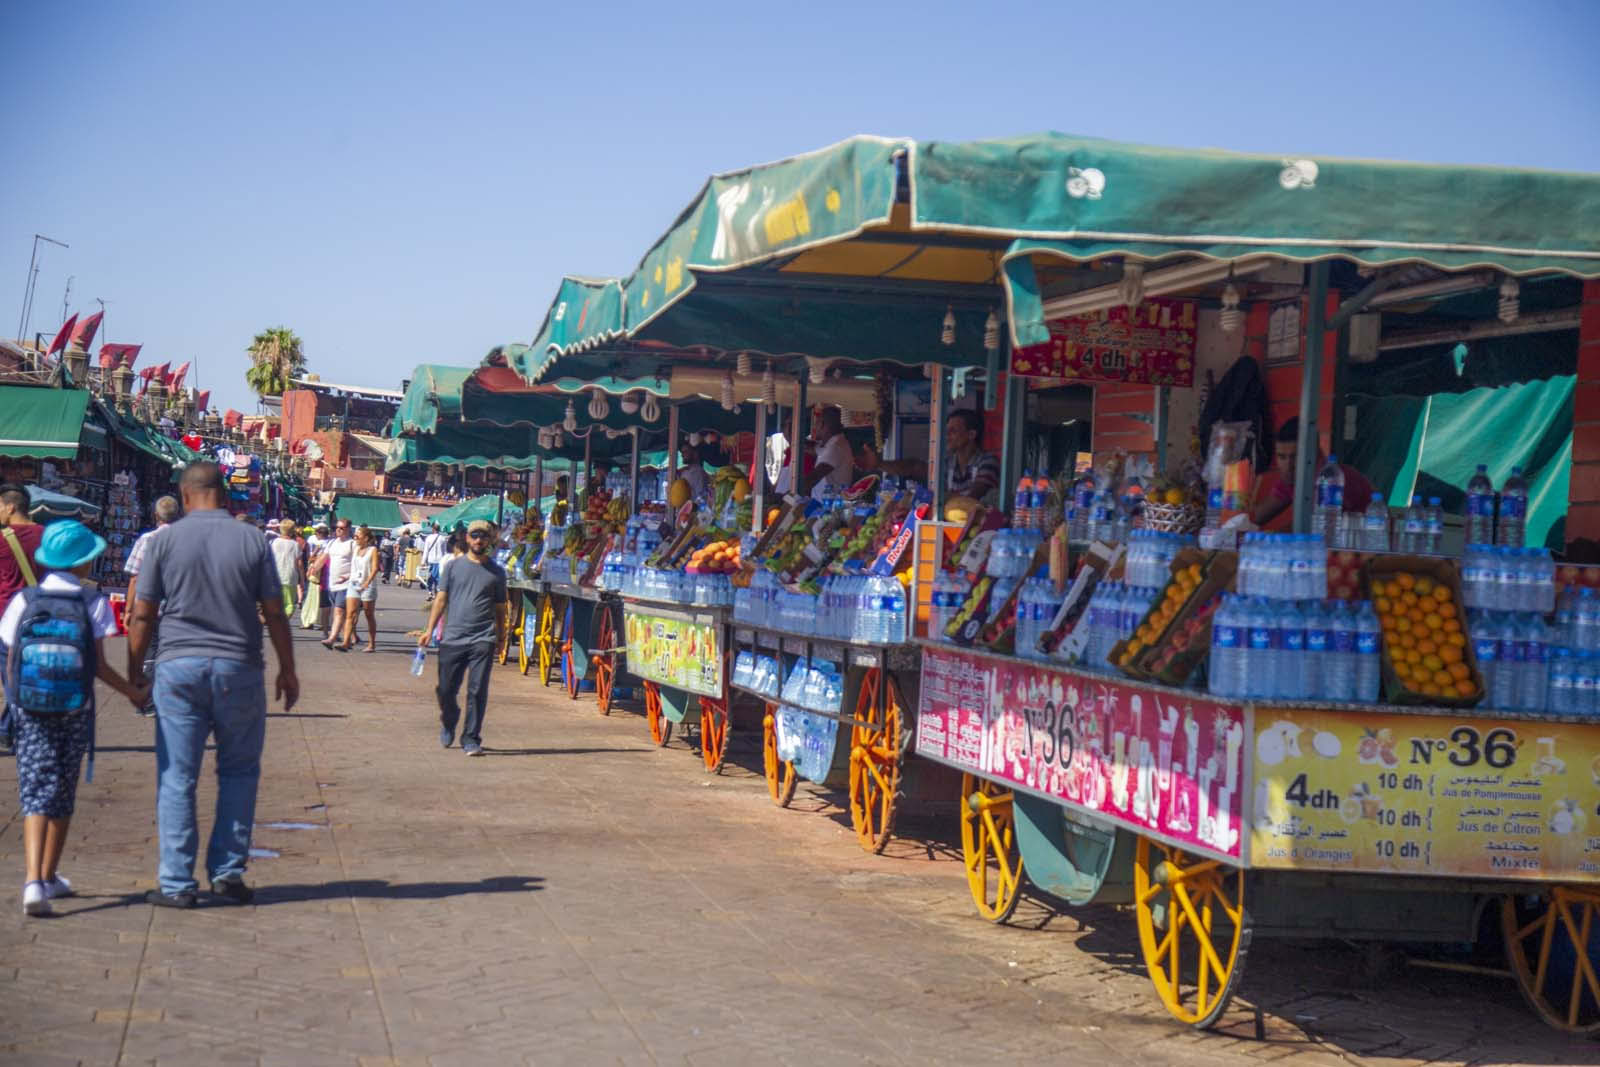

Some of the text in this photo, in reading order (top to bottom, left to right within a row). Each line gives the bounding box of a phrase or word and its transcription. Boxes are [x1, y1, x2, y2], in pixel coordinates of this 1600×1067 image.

[1082, 348, 1126, 368] 4 dh
[1379, 772, 1423, 791] 10 dh
[1377, 809, 1421, 827] 10 dh
[1457, 822, 1540, 835] Jus de Citron
[1267, 847, 1287, 857] Jus
[1376, 841, 1419, 858] 10 dh
[1492, 856, 1539, 868] Mixte
